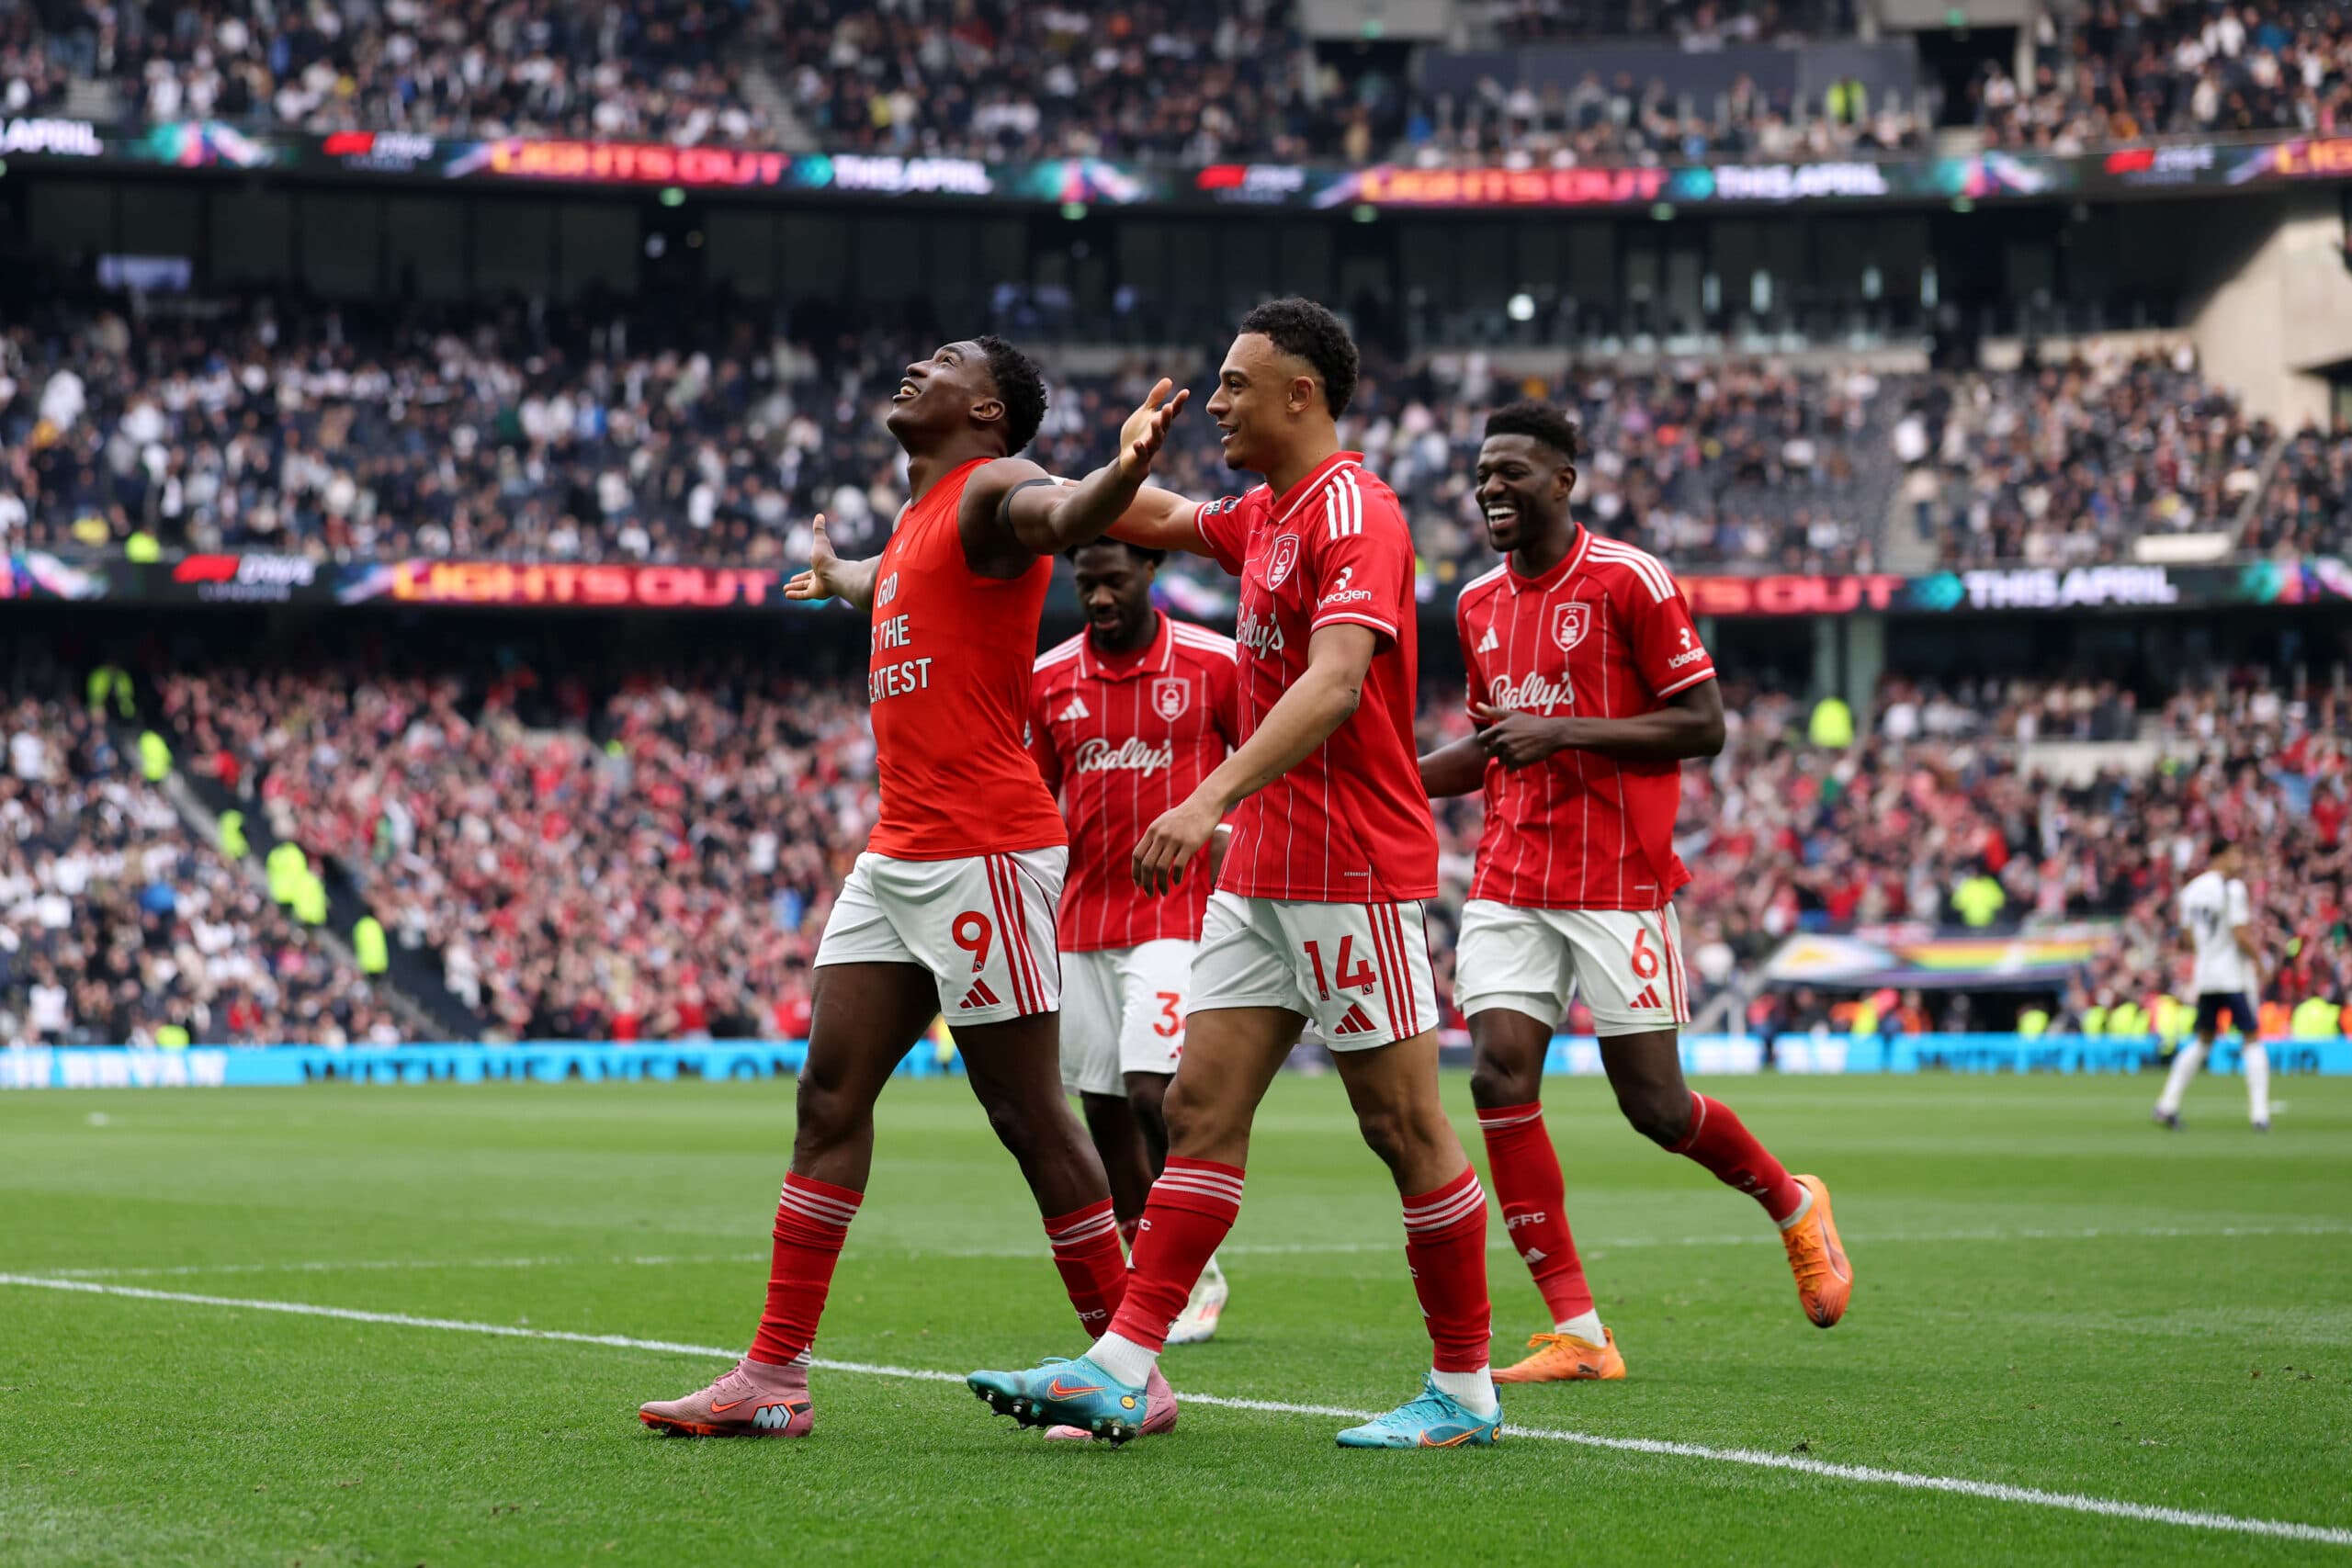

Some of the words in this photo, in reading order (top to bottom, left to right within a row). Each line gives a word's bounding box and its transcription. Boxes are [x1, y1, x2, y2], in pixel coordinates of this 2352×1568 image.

[393, 563, 632, 603] LIGHTS
[636, 566, 779, 607] OUT
[877, 571, 898, 608] GOD
[1757, 575, 1905, 614] OUT
[1964, 569, 2057, 609] THIS
[2059, 566, 2178, 606] APRIL
[879, 614, 910, 651] THE
[1490, 671, 1575, 716] Bally's
[1076, 736, 1173, 778] Bally's
[952, 911, 993, 973] 9
[1632, 929, 1659, 980] 6
[1304, 935, 1377, 1001] 14
[1153, 991, 1187, 1037] 3
